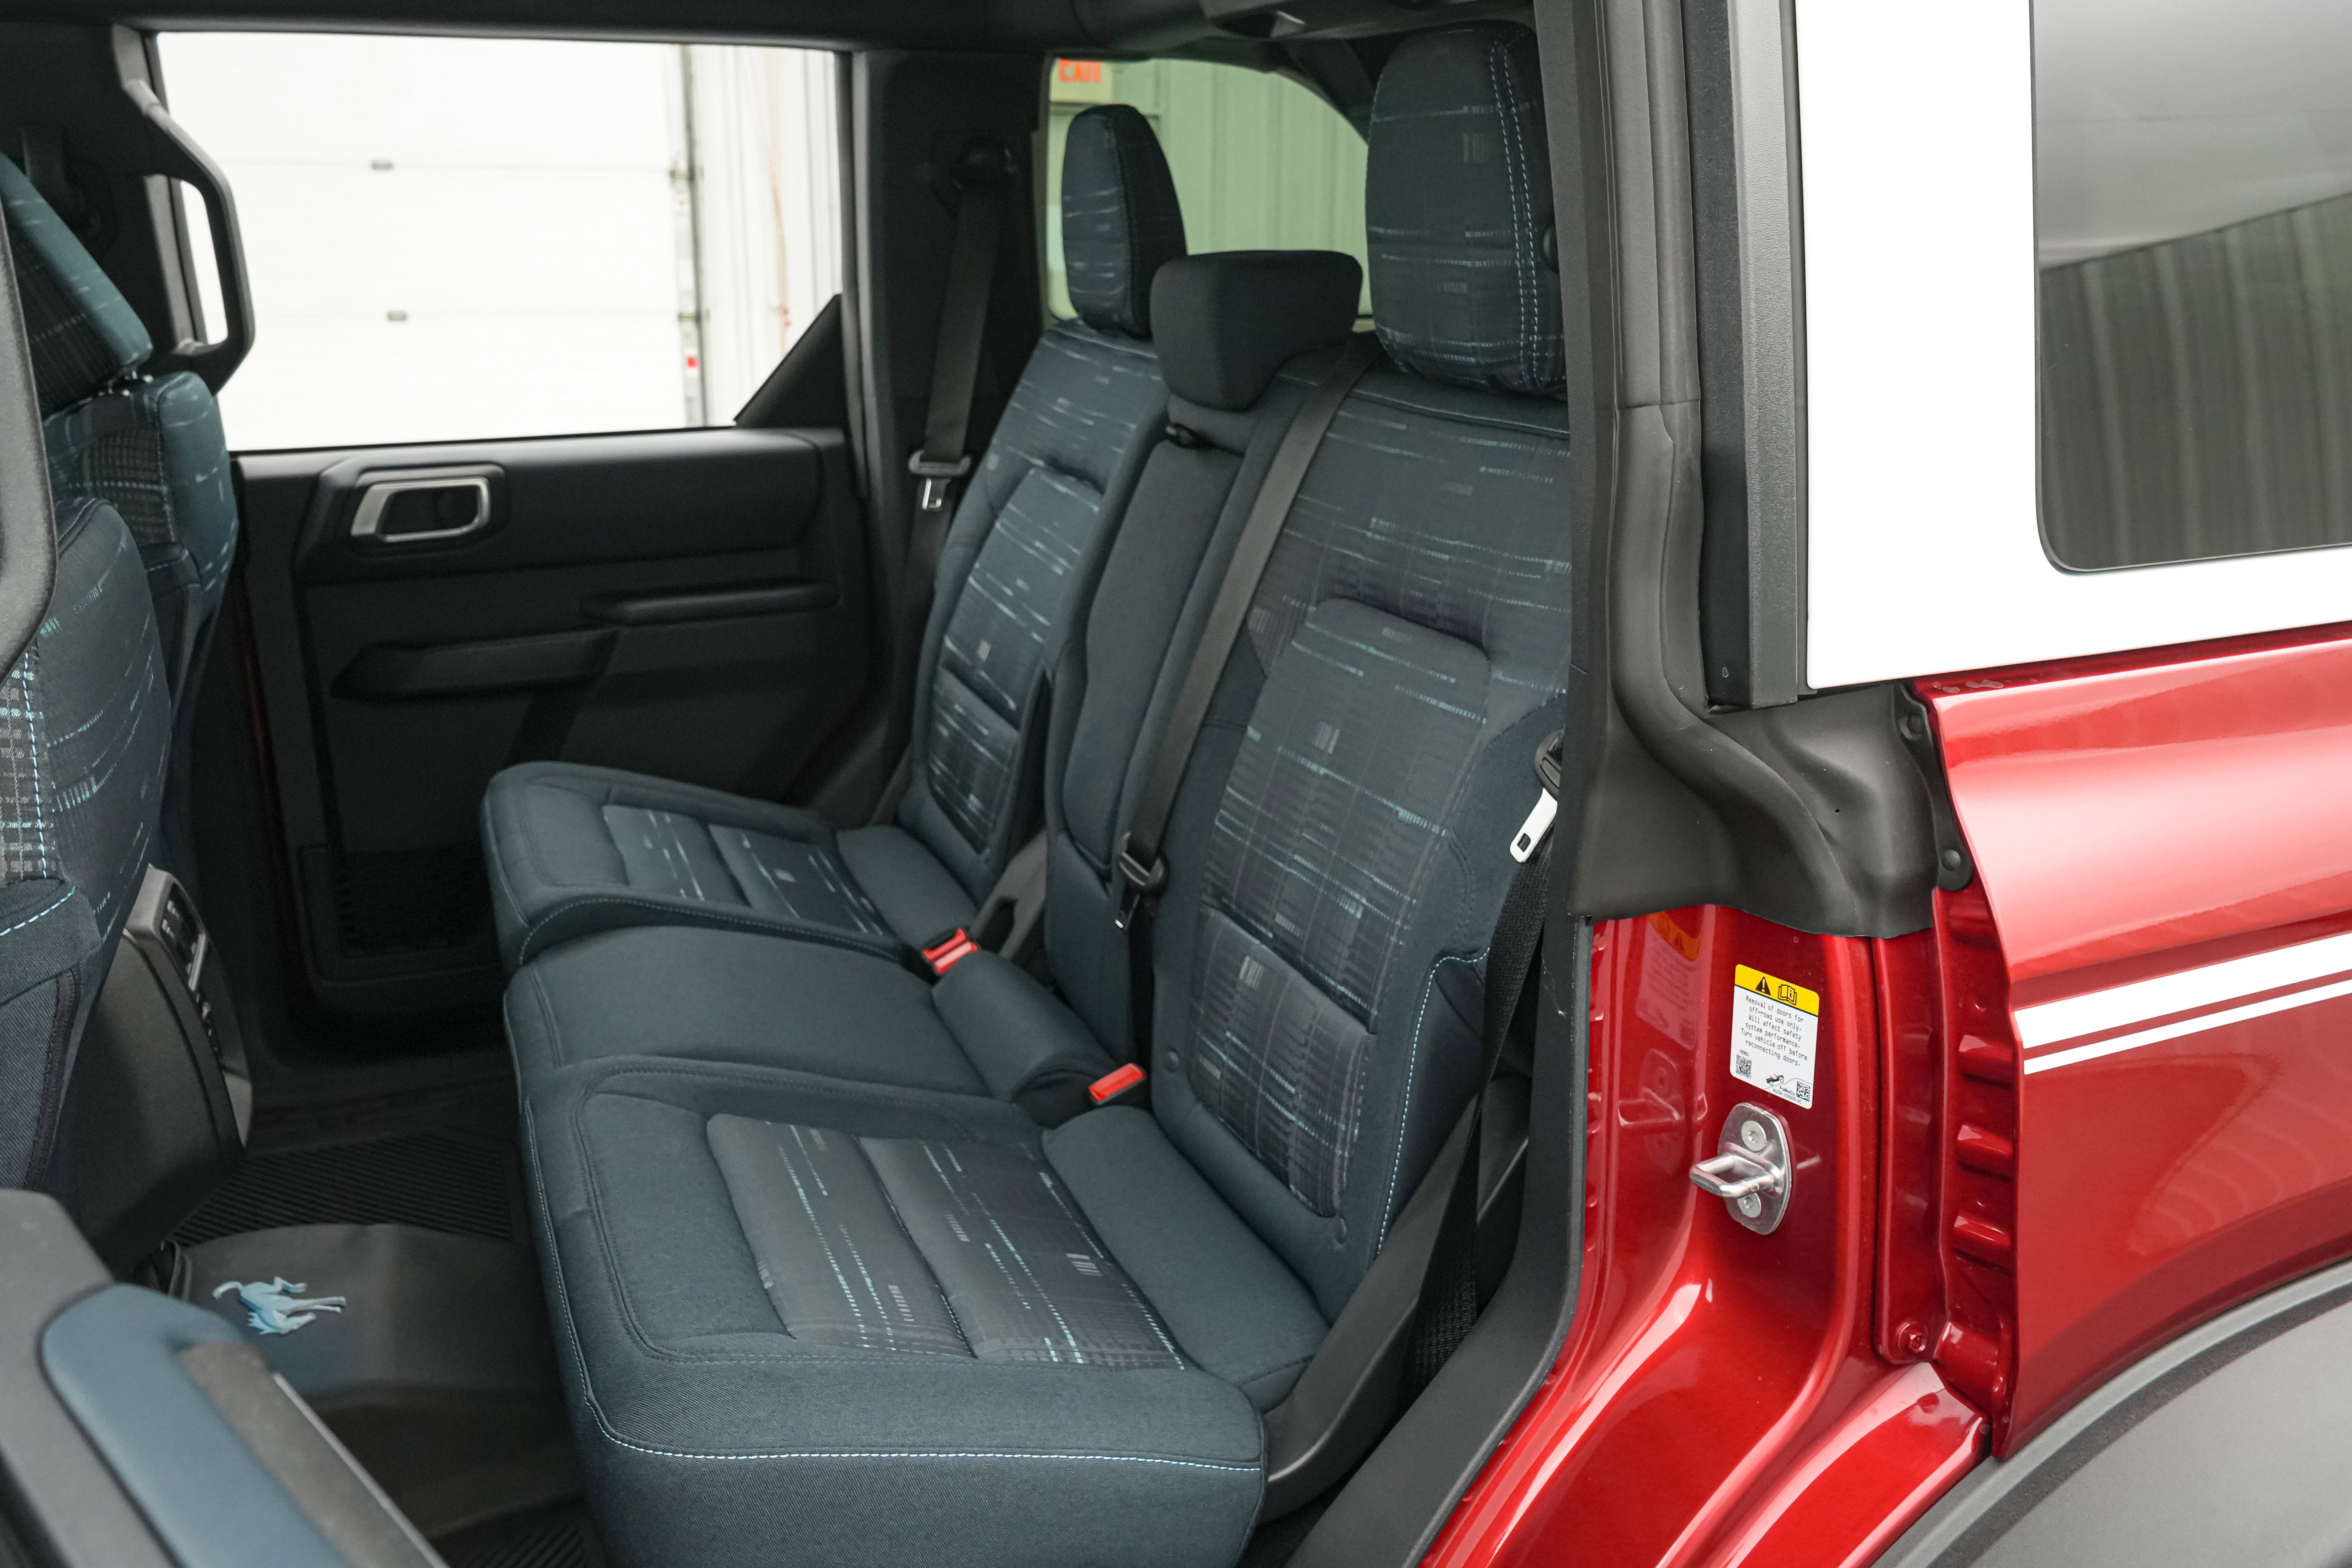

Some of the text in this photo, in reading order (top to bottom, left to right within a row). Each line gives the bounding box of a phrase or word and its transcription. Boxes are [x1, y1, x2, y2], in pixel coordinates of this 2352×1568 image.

[1746, 995, 1765, 1008] Removal
[1777, 1008, 1791, 1018] doors
[1749, 1007, 1772, 1020] off-road
[1787, 1022, 1801, 1031] only.
[1746, 1023, 1800, 1048] system performance.
[1749, 1014, 1802, 1041] Will affect safety
[1741, 1028, 1752, 1038] Turn
[1755, 1036, 1775, 1047] vehicle
[1789, 1048, 1808, 1060] before
[1746, 1040, 1800, 1066] reconnecting doors.
